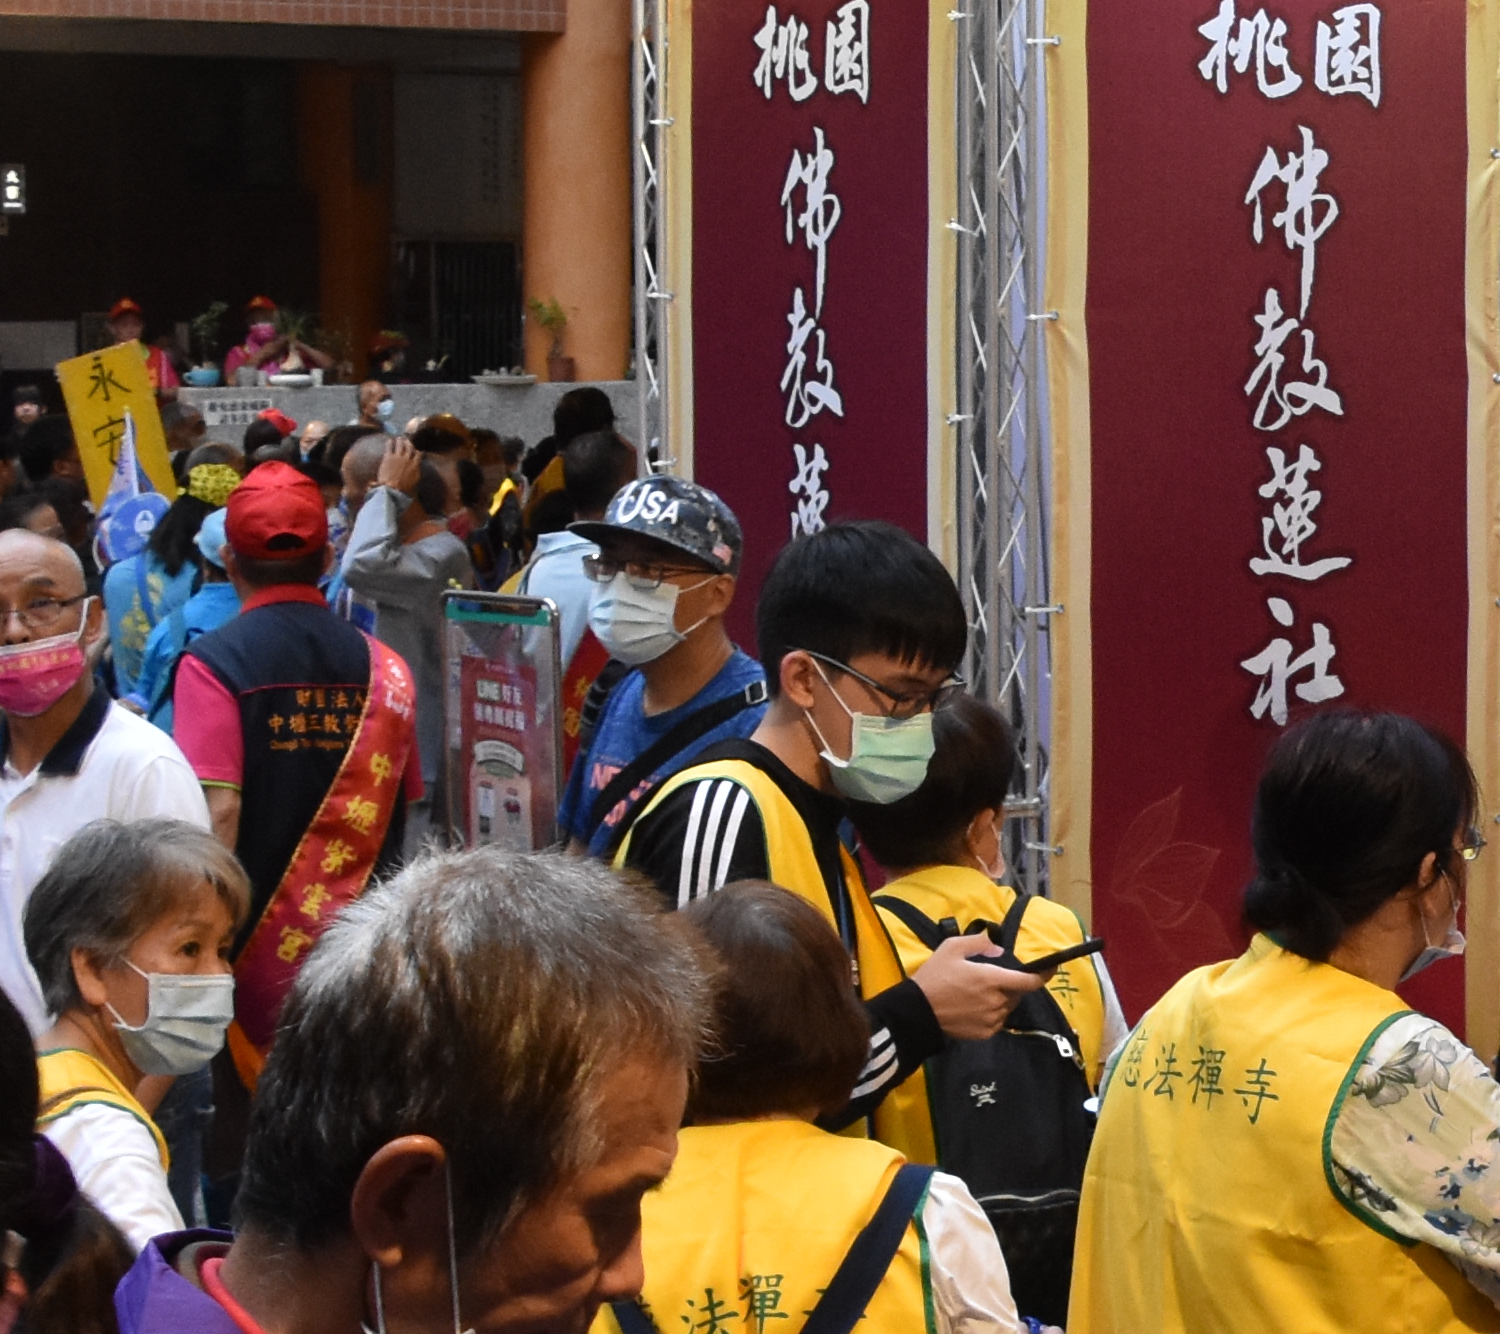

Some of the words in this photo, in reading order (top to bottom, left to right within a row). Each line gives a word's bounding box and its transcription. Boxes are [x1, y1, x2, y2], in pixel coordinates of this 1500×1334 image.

[1239, 125, 1353, 727] 佛教蓮社
[616, 479, 680, 525] USA
[1120, 1028, 1280, 1126] 慈法禪寺
